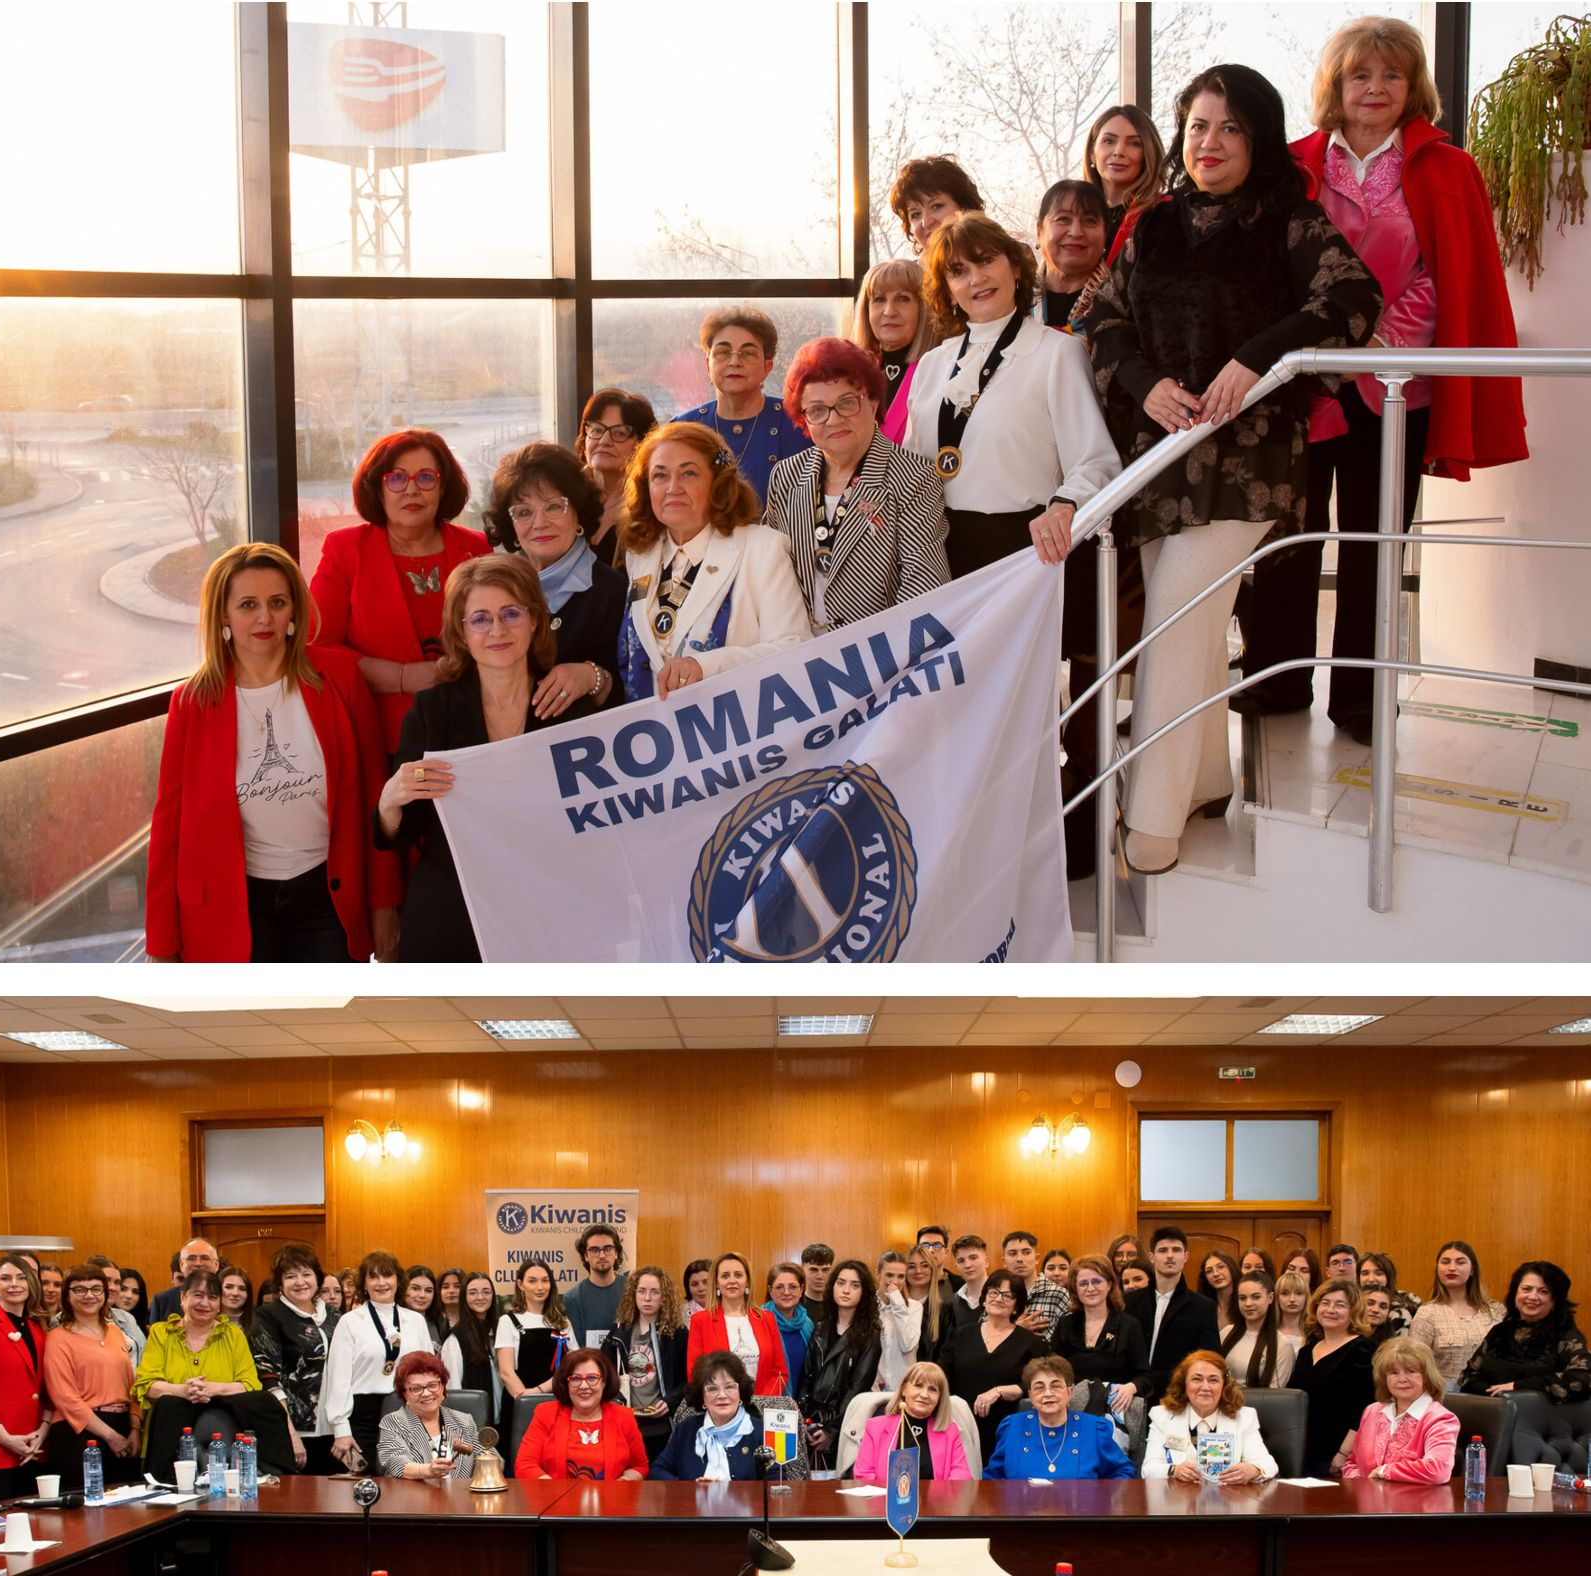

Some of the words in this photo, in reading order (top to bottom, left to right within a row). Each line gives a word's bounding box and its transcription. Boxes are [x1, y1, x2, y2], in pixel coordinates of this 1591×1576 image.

[549, 612, 956, 799] ROMANIA
[564, 744, 788, 834] KIWANIS
[802, 650, 966, 751] GALATI
[236, 773, 324, 807] Bonjour
[278, 787, 322, 806] Paris
[722, 780, 856, 881] KIWAS
[530, 1204, 627, 1224] Kiwanis
[530, 1226, 562, 1234] KIWANIS
[563, 1226, 585, 1234] CHILD
[507, 1249, 564, 1263] KIWANIS
[494, 1269, 519, 1283] CLU
[551, 1269, 578, 1283] LATI
